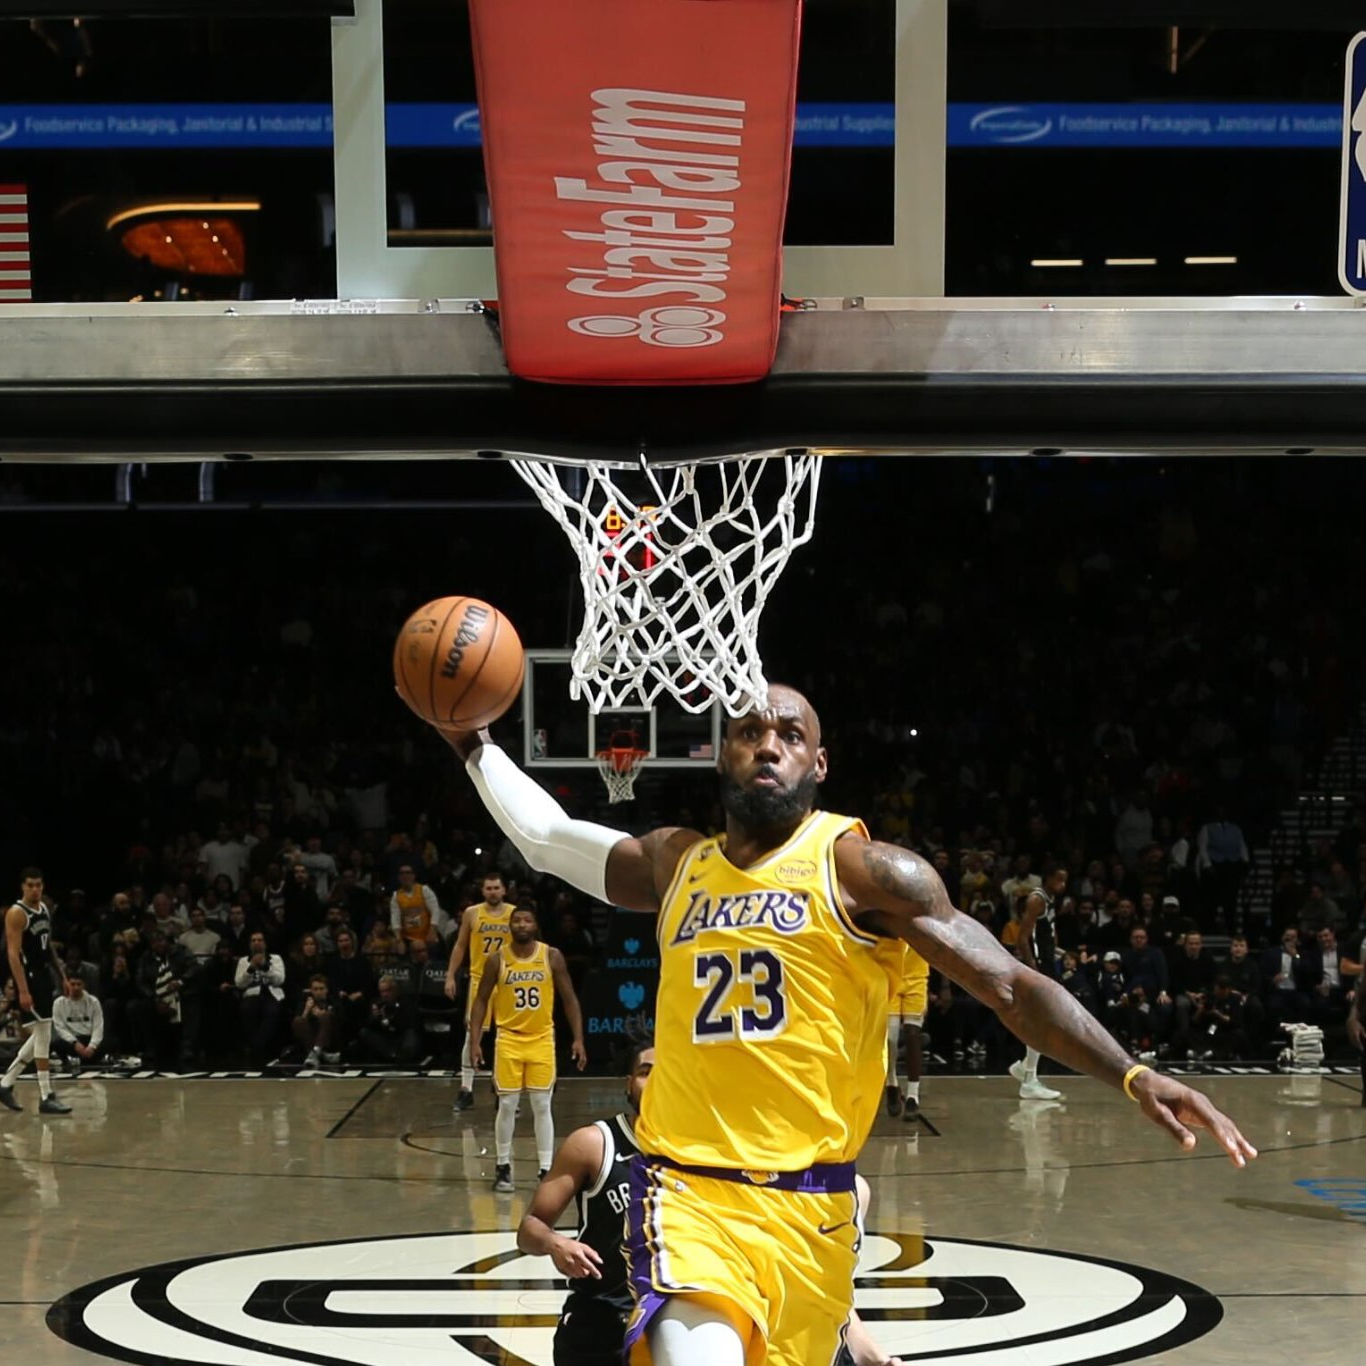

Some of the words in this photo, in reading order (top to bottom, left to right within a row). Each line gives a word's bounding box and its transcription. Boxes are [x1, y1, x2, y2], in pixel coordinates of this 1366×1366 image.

[440, 605, 489, 680] Wilson
[670, 889, 809, 947] LAKERS
[483, 937, 504, 954] 77
[505, 970, 545, 985] LAKERS
[514, 986, 540, 1009] 36
[694, 950, 788, 1042] 23
